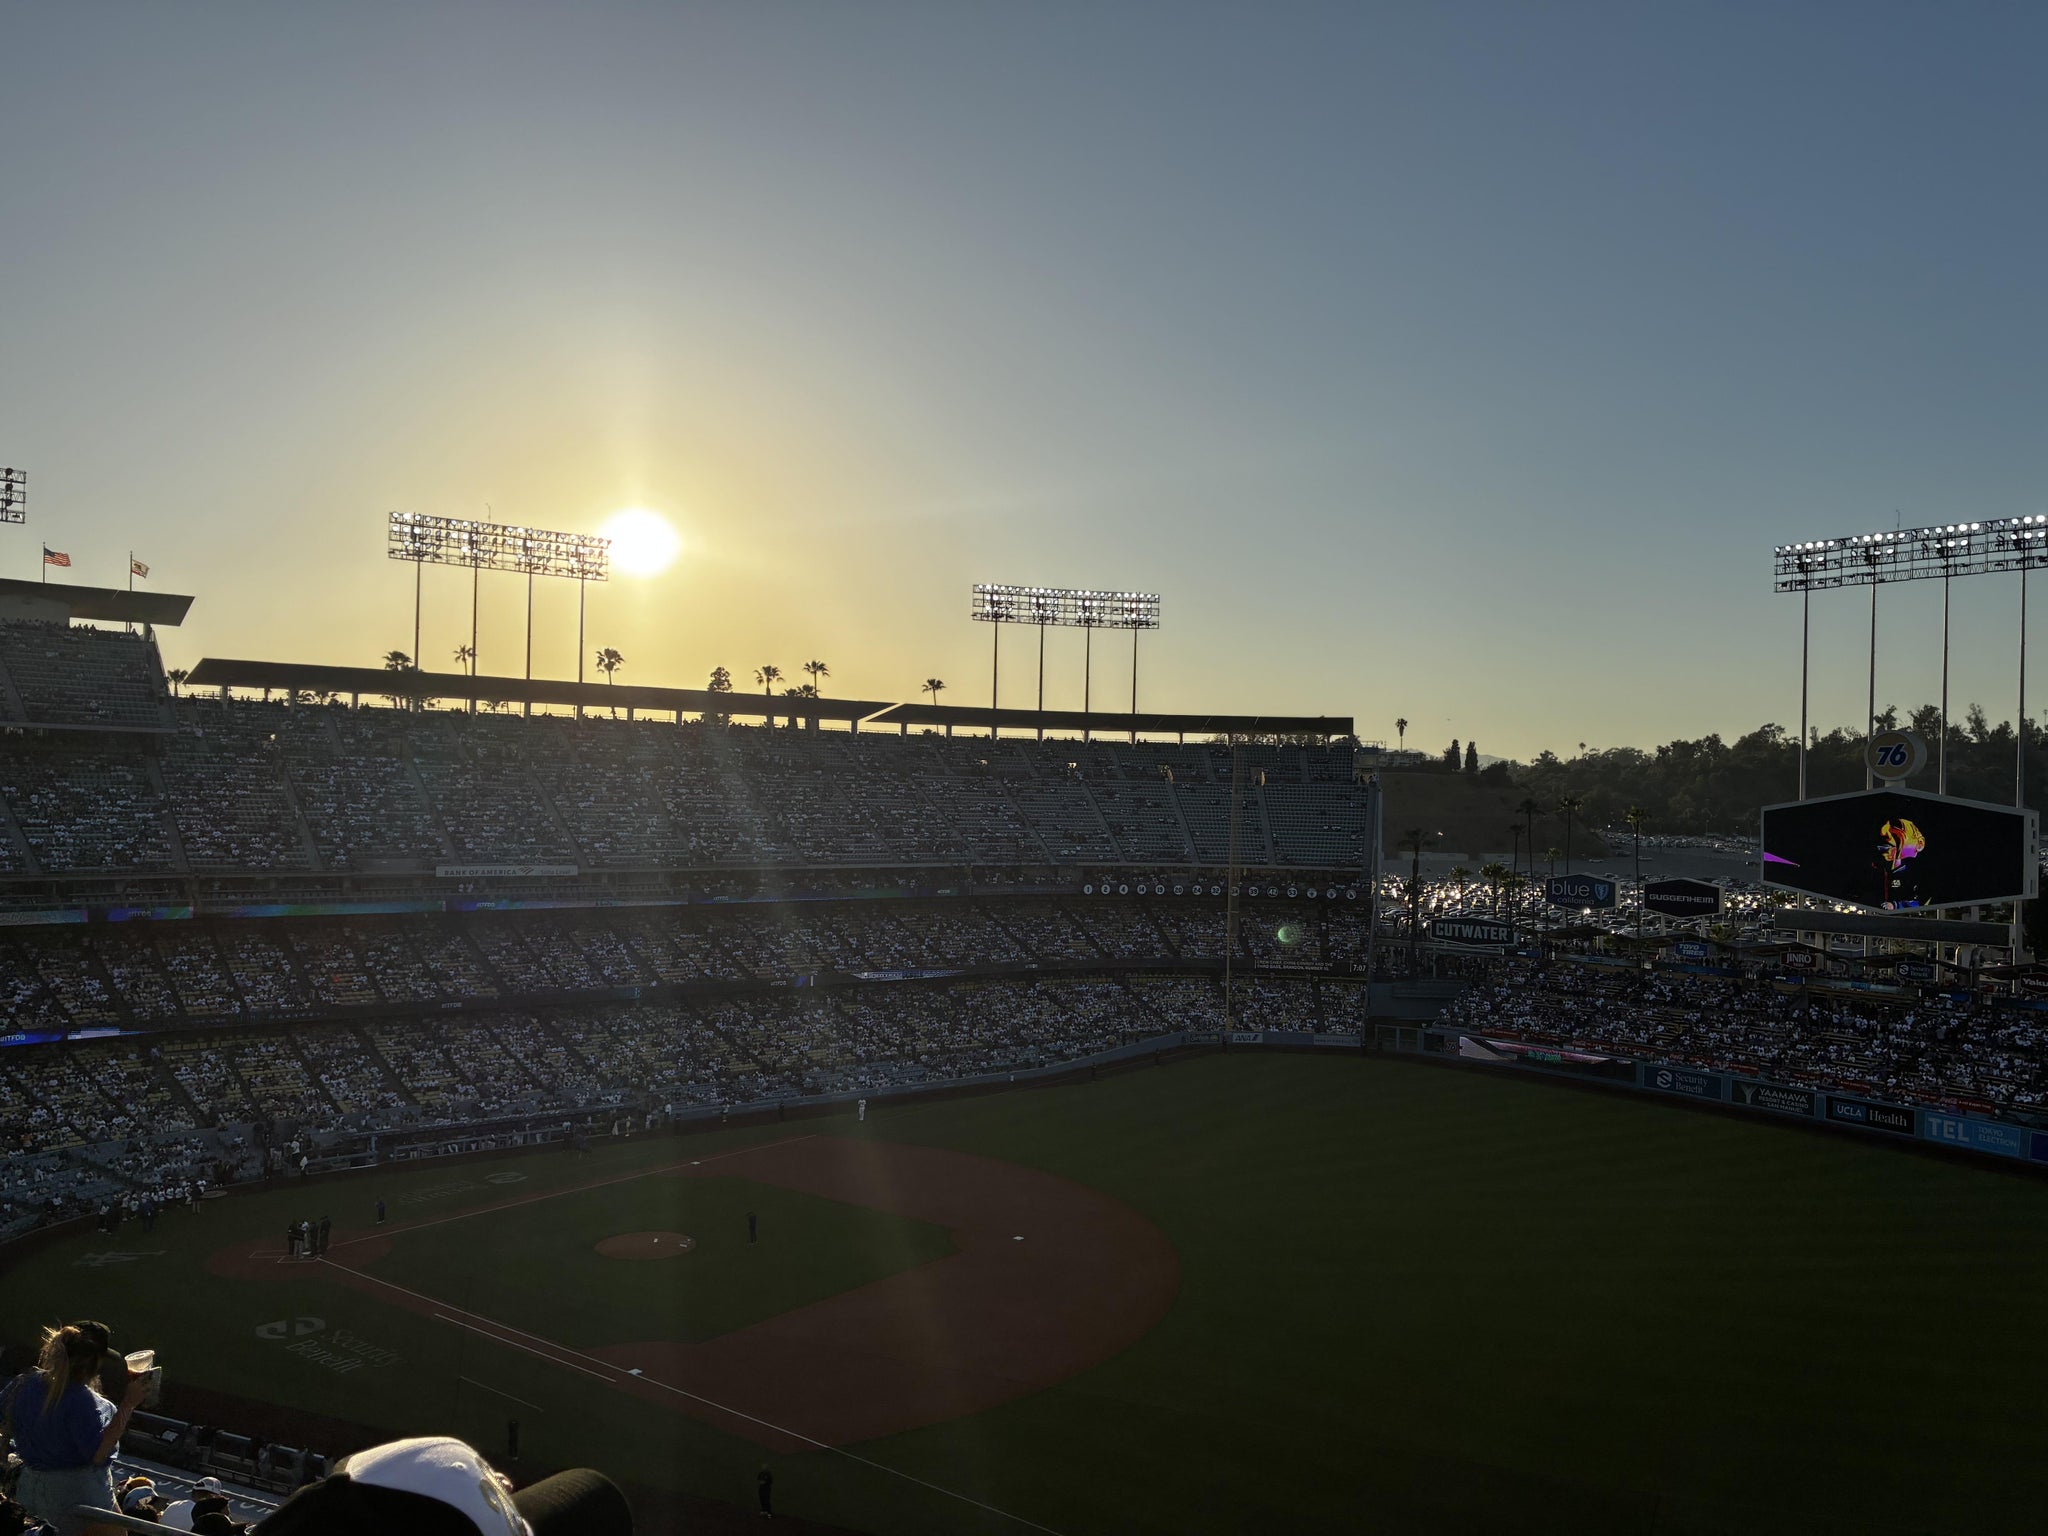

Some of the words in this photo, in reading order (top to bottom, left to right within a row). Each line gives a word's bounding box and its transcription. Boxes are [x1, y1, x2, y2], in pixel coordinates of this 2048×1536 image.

[1876, 743, 1908, 766] 76
[1552, 880, 1590, 897] blue
[1557, 896, 1595, 905] california
[1649, 893, 1714, 904] GUGGENHEIM
[1436, 923, 1508, 941] CUTWATER
[1786, 953, 1811, 964] JINRO
[1353, 964, 1366, 972] 7:07
[1675, 1072, 1708, 1088] Security
[1675, 1081, 1703, 1095] Benefit
[1837, 1104, 1862, 1117] UCLA
[1869, 1109, 1907, 1127] Health
[1928, 1118, 1969, 1143] TEL
[1978, 1126, 2004, 1138] TOKYO
[1978, 1133, 2017, 1148] ELECTRON
